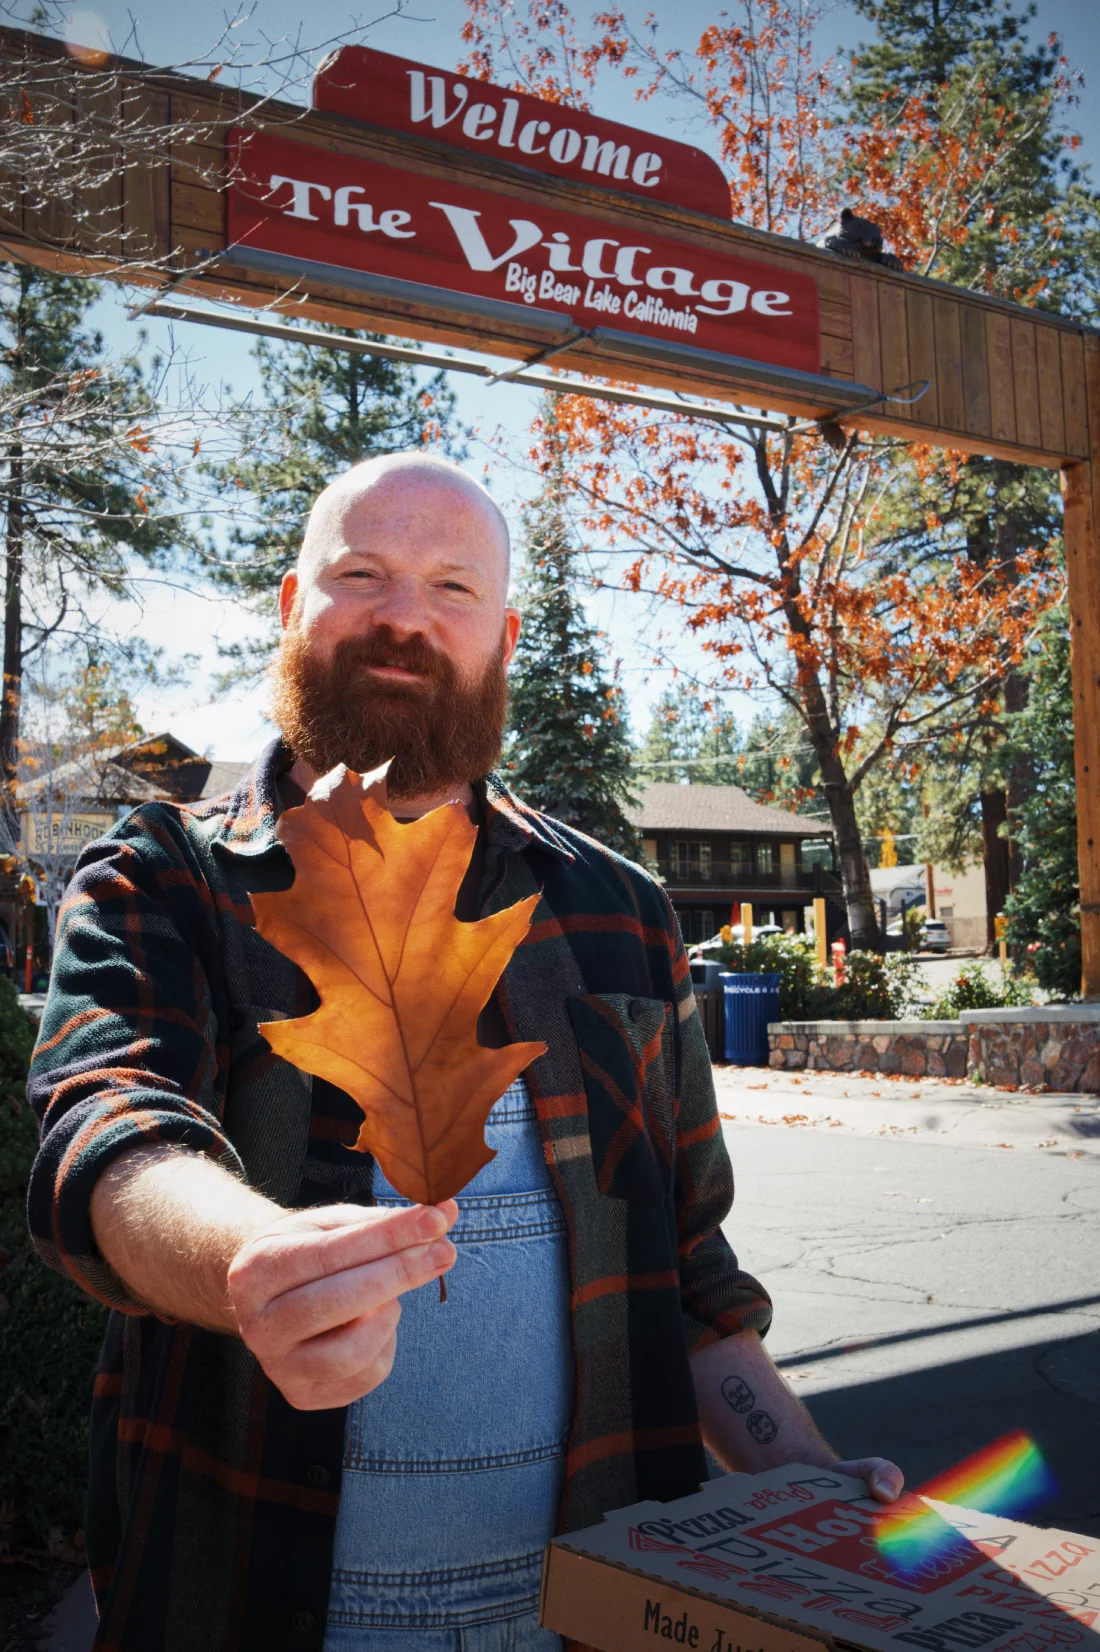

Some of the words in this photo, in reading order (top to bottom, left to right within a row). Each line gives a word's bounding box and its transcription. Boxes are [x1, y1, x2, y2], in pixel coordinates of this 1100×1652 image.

[405, 69, 663, 188] Welcome
[268, 174, 416, 239] The
[428, 200, 794, 316] Village
[504, 262, 538, 303] Big
[538, 269, 582, 306] Bear
[583, 278, 621, 315] Lake
[622, 289, 698, 335] California
[636, 1506, 755, 1545] Pizza
[758, 1502, 883, 1555] Hot
[692, 1537, 924, 1621] Pizza
[980, 1540, 1097, 1593] Pizza
[643, 1598, 700, 1650] Made
[954, 1584, 1099, 1628] PIZZA
